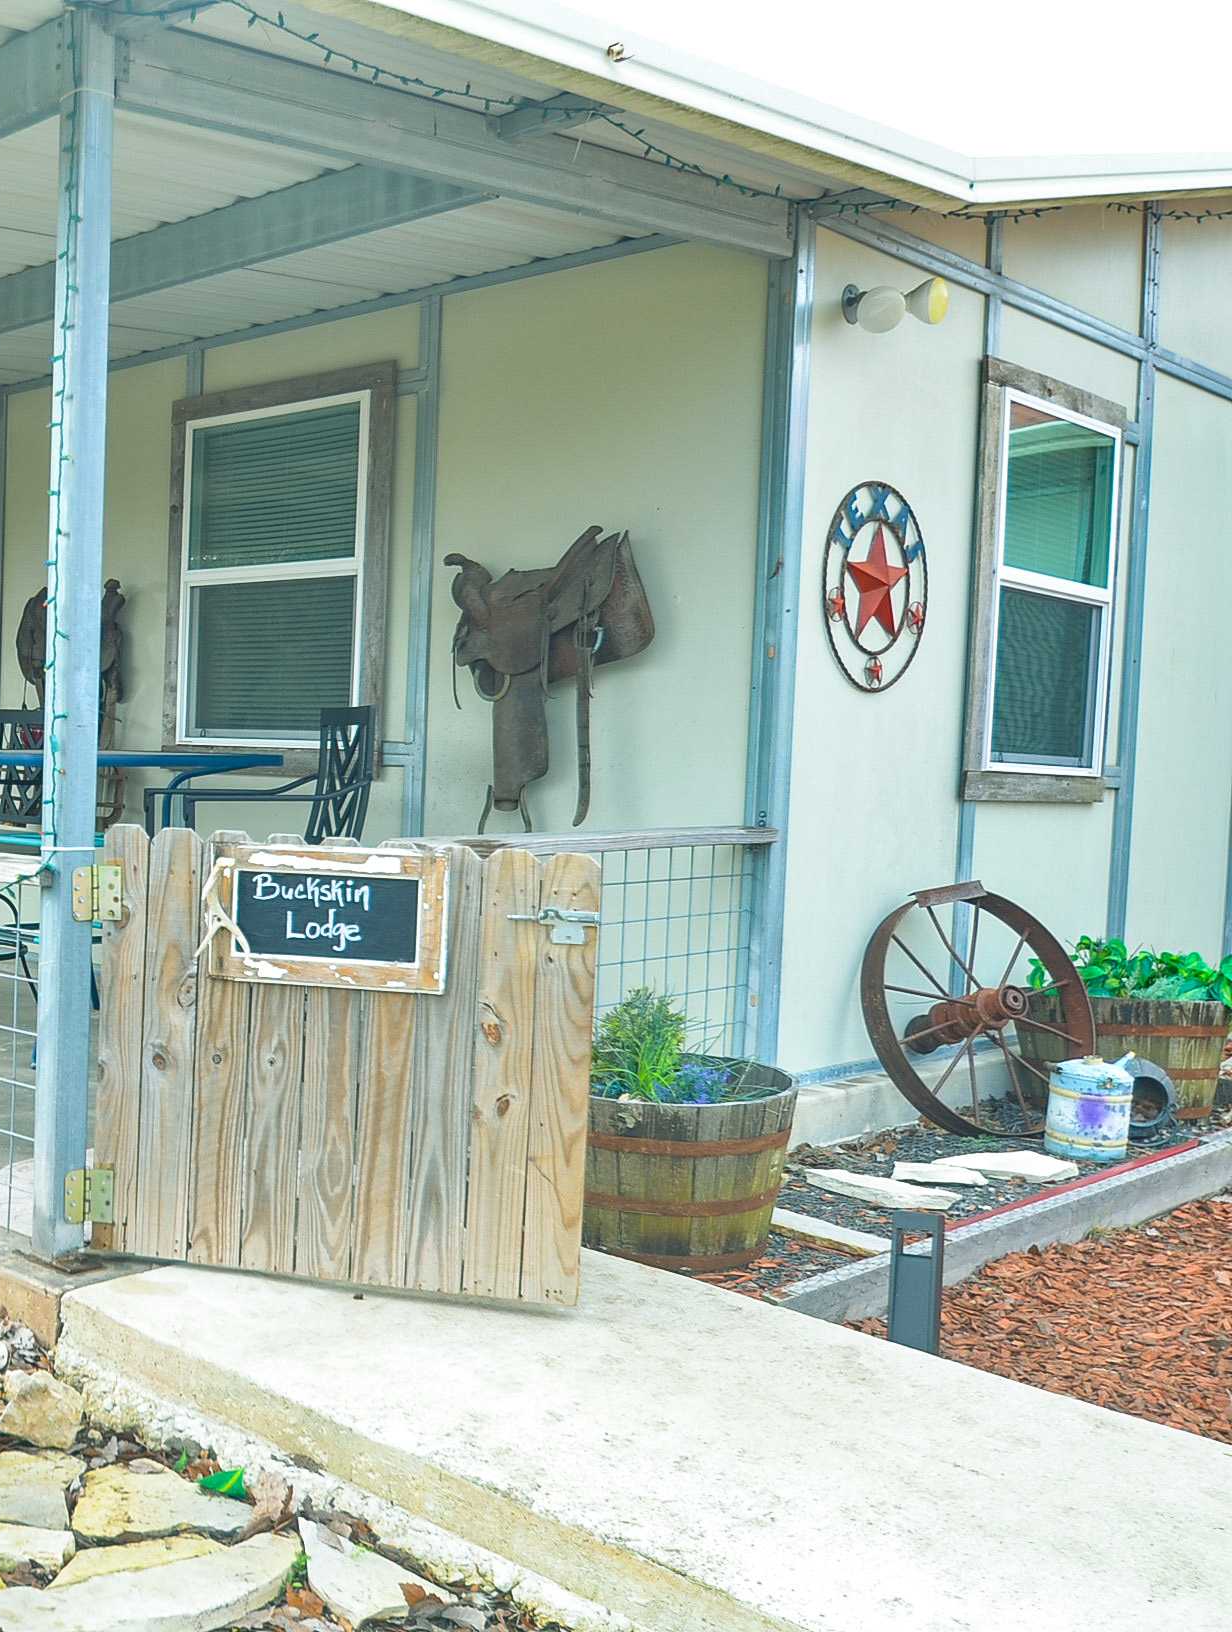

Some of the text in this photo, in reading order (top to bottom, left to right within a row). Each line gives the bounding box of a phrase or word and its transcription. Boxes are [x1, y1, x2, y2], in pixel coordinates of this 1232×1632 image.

[830, 484, 923, 563] TEXAS
[252, 873, 371, 911] Buckskin
[286, 908, 362, 951] Lodge
